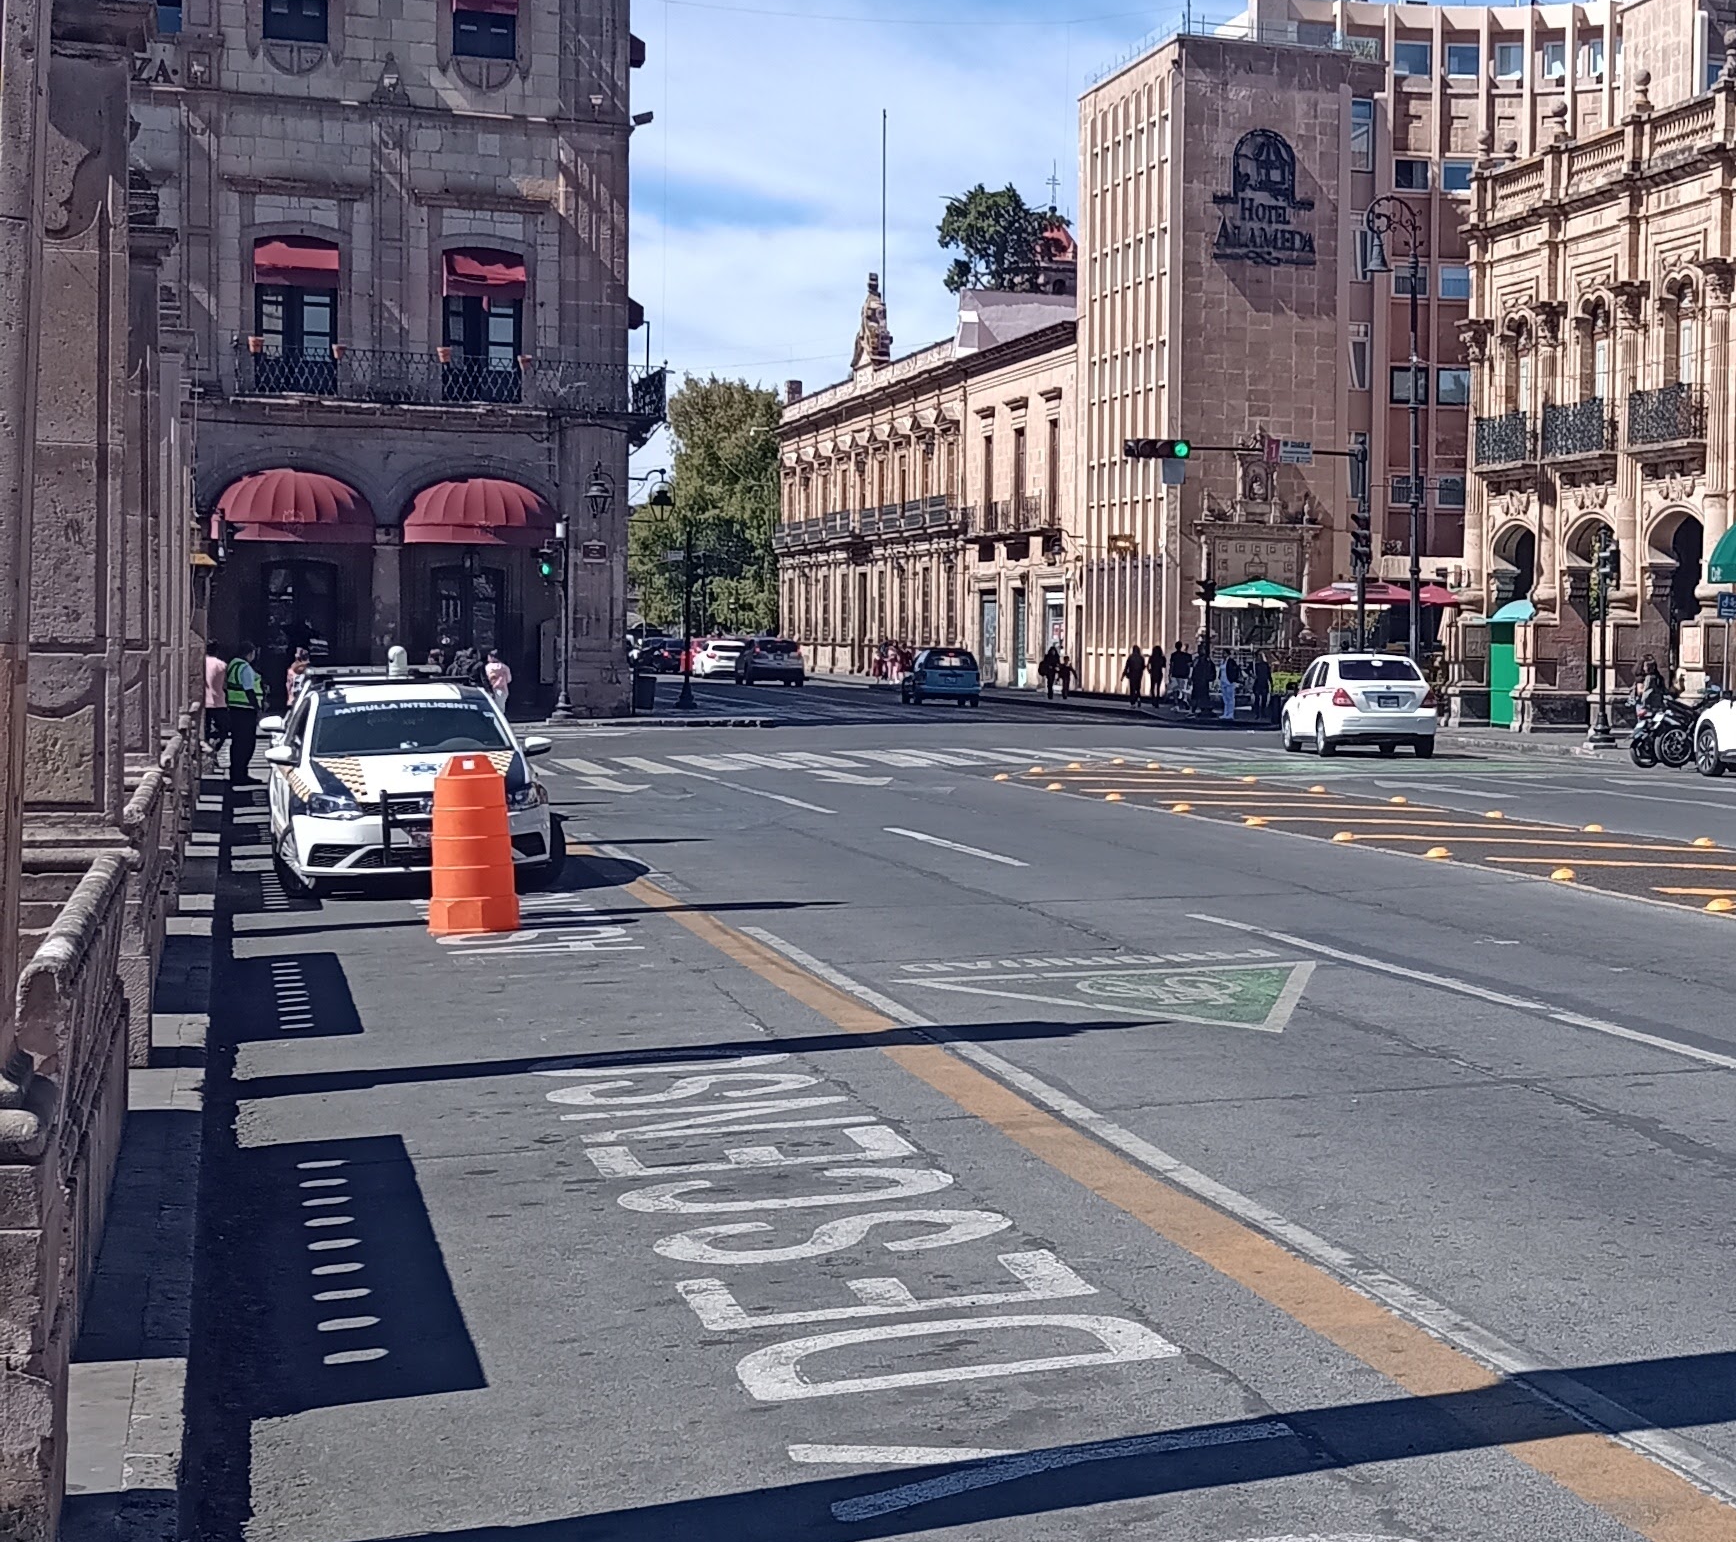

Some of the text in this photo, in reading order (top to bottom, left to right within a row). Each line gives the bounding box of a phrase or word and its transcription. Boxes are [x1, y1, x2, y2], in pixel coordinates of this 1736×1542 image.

[1213, 216, 1316, 254] ALAMEDA
[334, 701, 479, 716] PATRULLA INTELIGENTE
[527, 1049, 1183, 1401] DESCENSO
